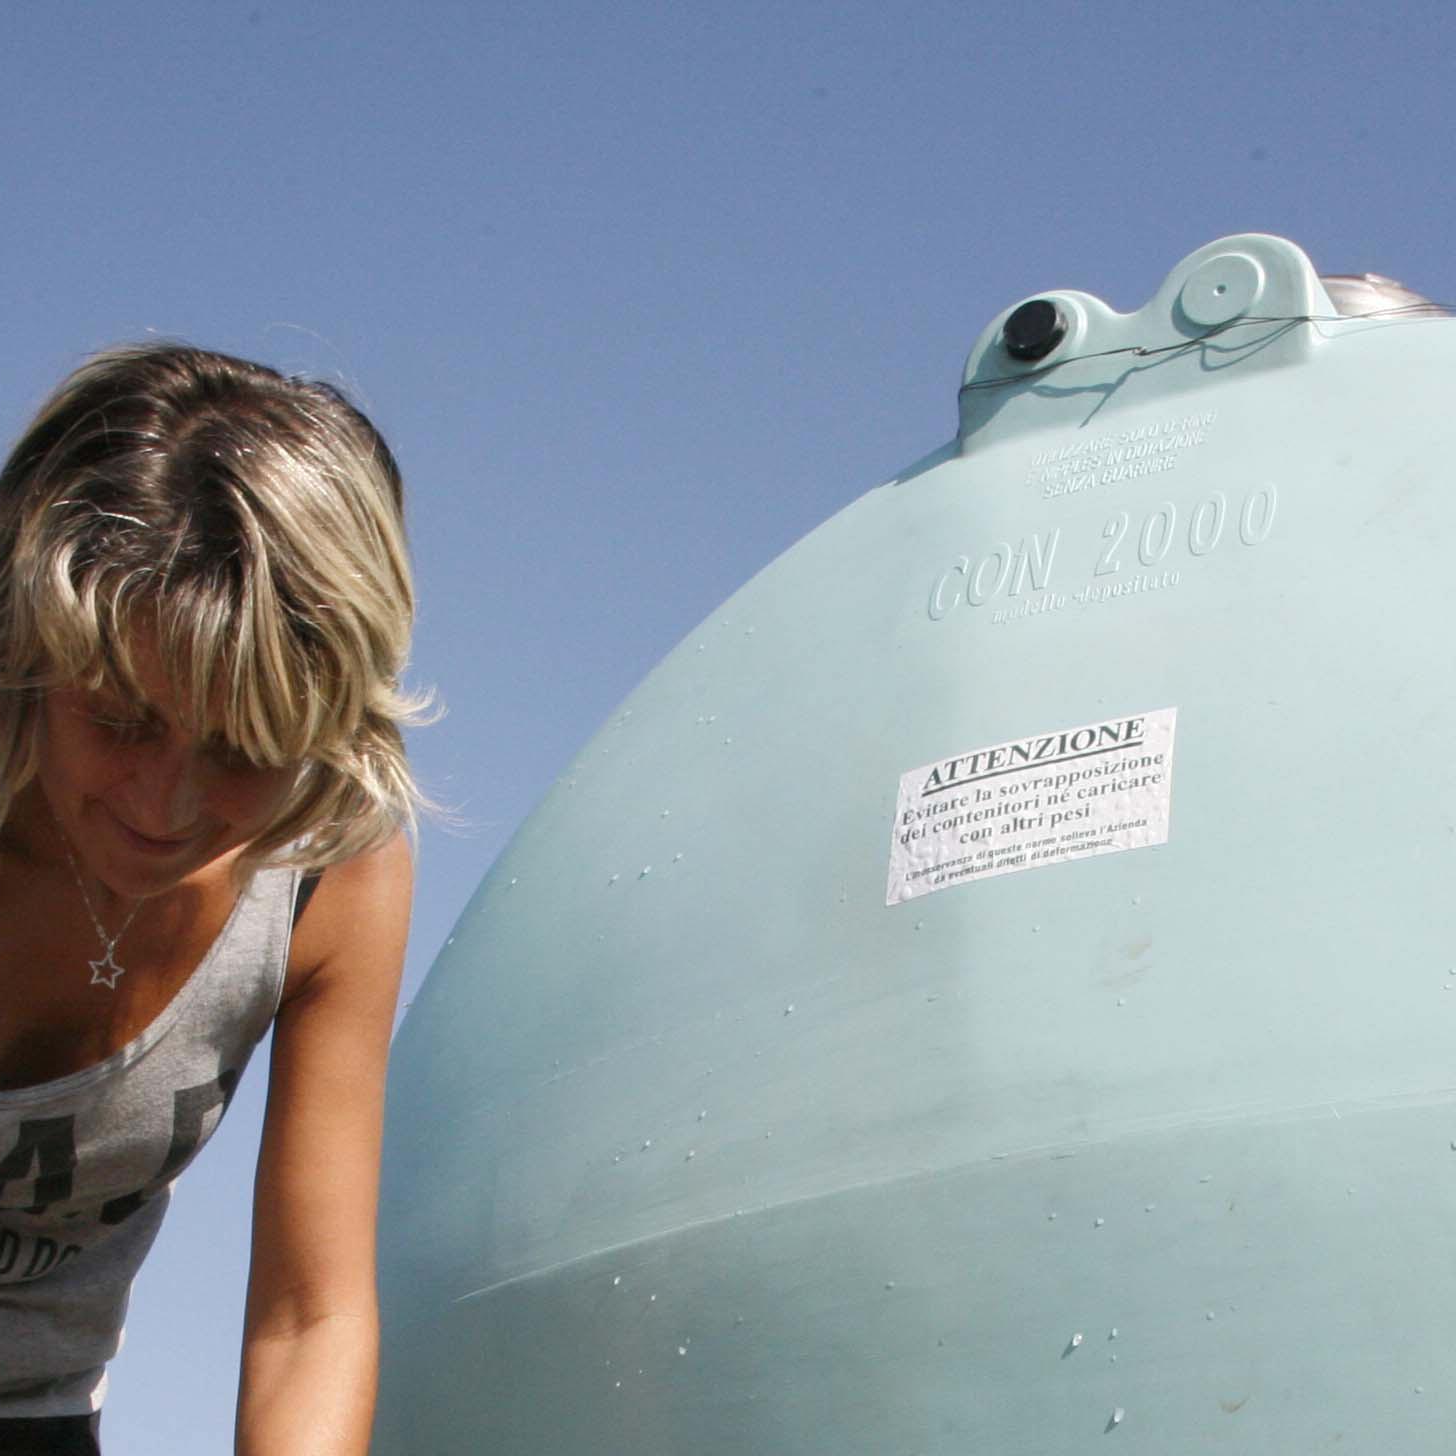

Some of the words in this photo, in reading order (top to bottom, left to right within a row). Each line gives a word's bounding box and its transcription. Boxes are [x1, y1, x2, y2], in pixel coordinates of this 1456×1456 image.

[1043, 473, 1095, 499] SENZA
[927, 527, 1061, 622] CON
[1093, 482, 1279, 577] 2000
[922, 717, 1145, 791] ATTENZIONE
[899, 823, 927, 846] dei
[932, 794, 1041, 834] contenitori
[1076, 773, 1162, 801] caricare
[902, 795, 969, 826] Evitare
[975, 788, 993, 803] la
[998, 752, 1165, 798] sovrapposizione
[959, 827, 993, 845] con
[1000, 810, 1044, 836] altri
[1050, 802, 1091, 829] pesi
[976, 850, 987, 861] di
[988, 843, 1022, 859] queste
[1025, 836, 1057, 850] norme
[1060, 828, 1097, 842] solleva
[1099, 818, 1148, 835] l'Azienda
[1043, 837, 1113, 860] deformazione
